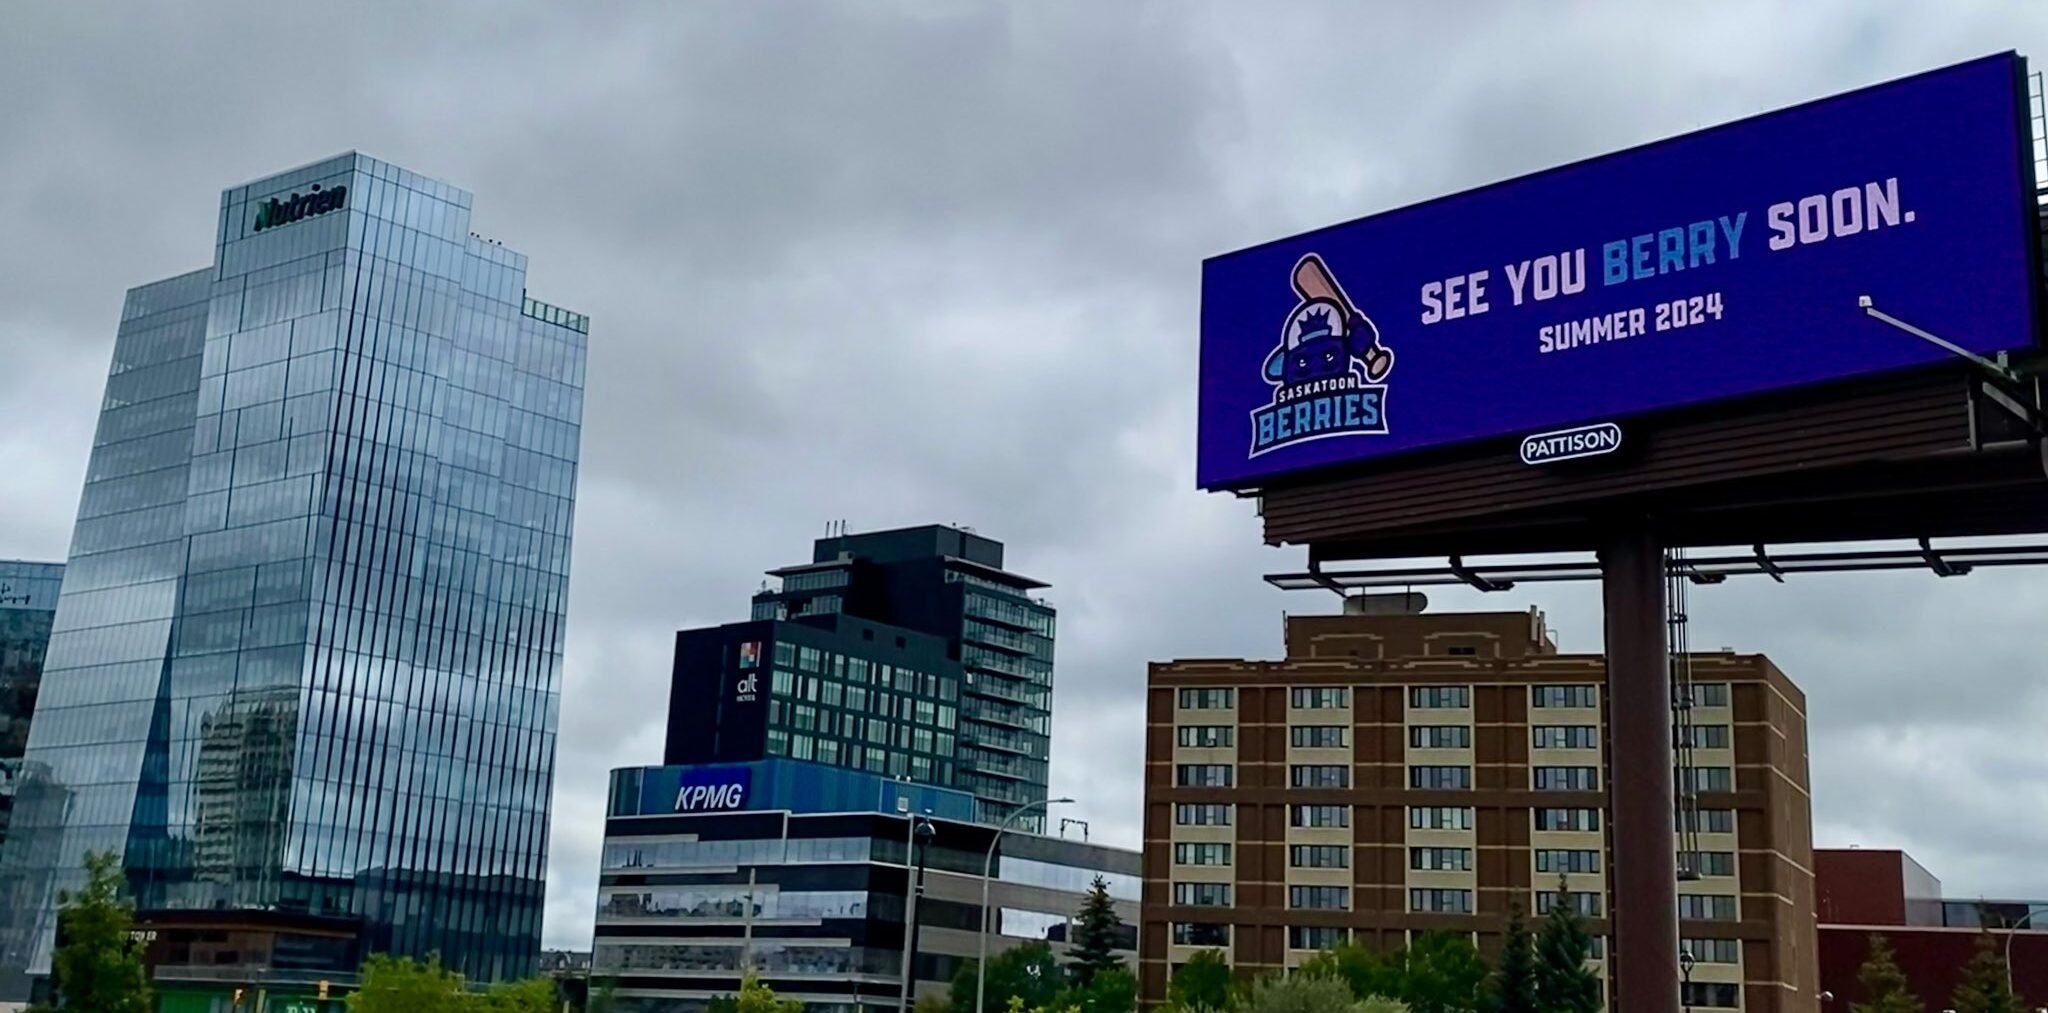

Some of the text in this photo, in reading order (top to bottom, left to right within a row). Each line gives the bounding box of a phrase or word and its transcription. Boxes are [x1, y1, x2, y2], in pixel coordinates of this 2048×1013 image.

[254, 184, 347, 232] Nutrien
[1421, 177, 1916, 325] SEE YOU BERRY SOON.
[1539, 292, 1723, 353] SUMMER 2024
[1279, 377, 1355, 403] SASKATOON
[1258, 393, 1378, 446] BERRIES
[1526, 429, 1615, 459] PATTISON
[737, 673, 757, 693] alt
[675, 783, 743, 810] KPMG
